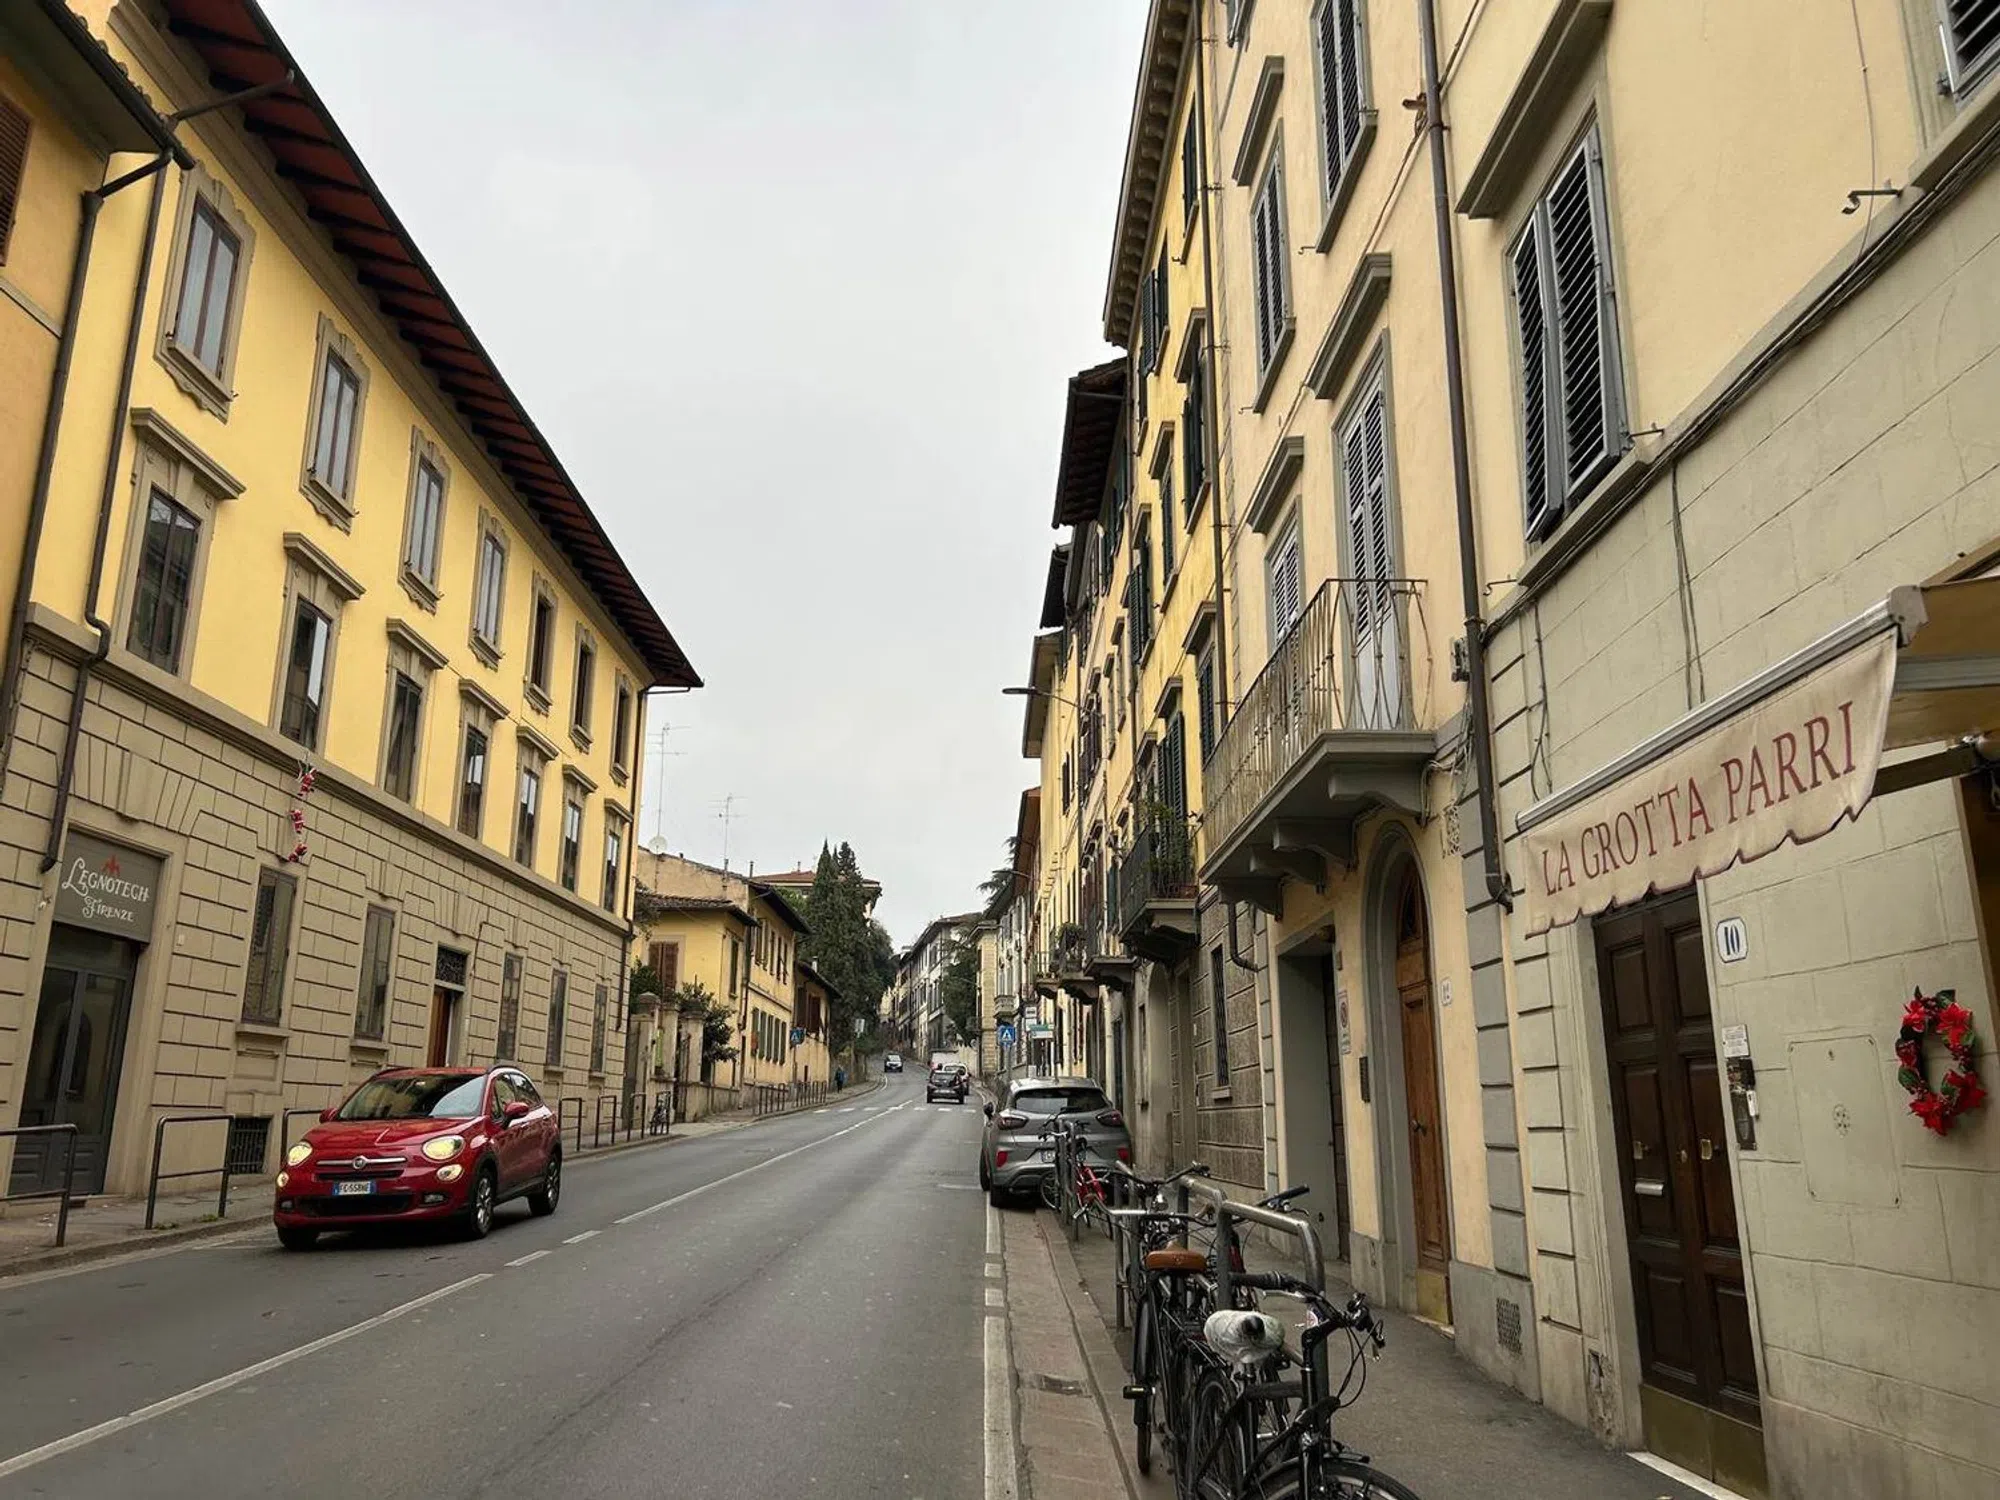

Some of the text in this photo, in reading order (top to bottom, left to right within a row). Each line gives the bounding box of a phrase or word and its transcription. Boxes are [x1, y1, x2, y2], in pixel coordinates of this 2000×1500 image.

[1542, 701, 1856, 896] LA GROTTA PARRI
[82, 896, 134, 922] FIRENZE
[1724, 924, 1740, 955] 10
